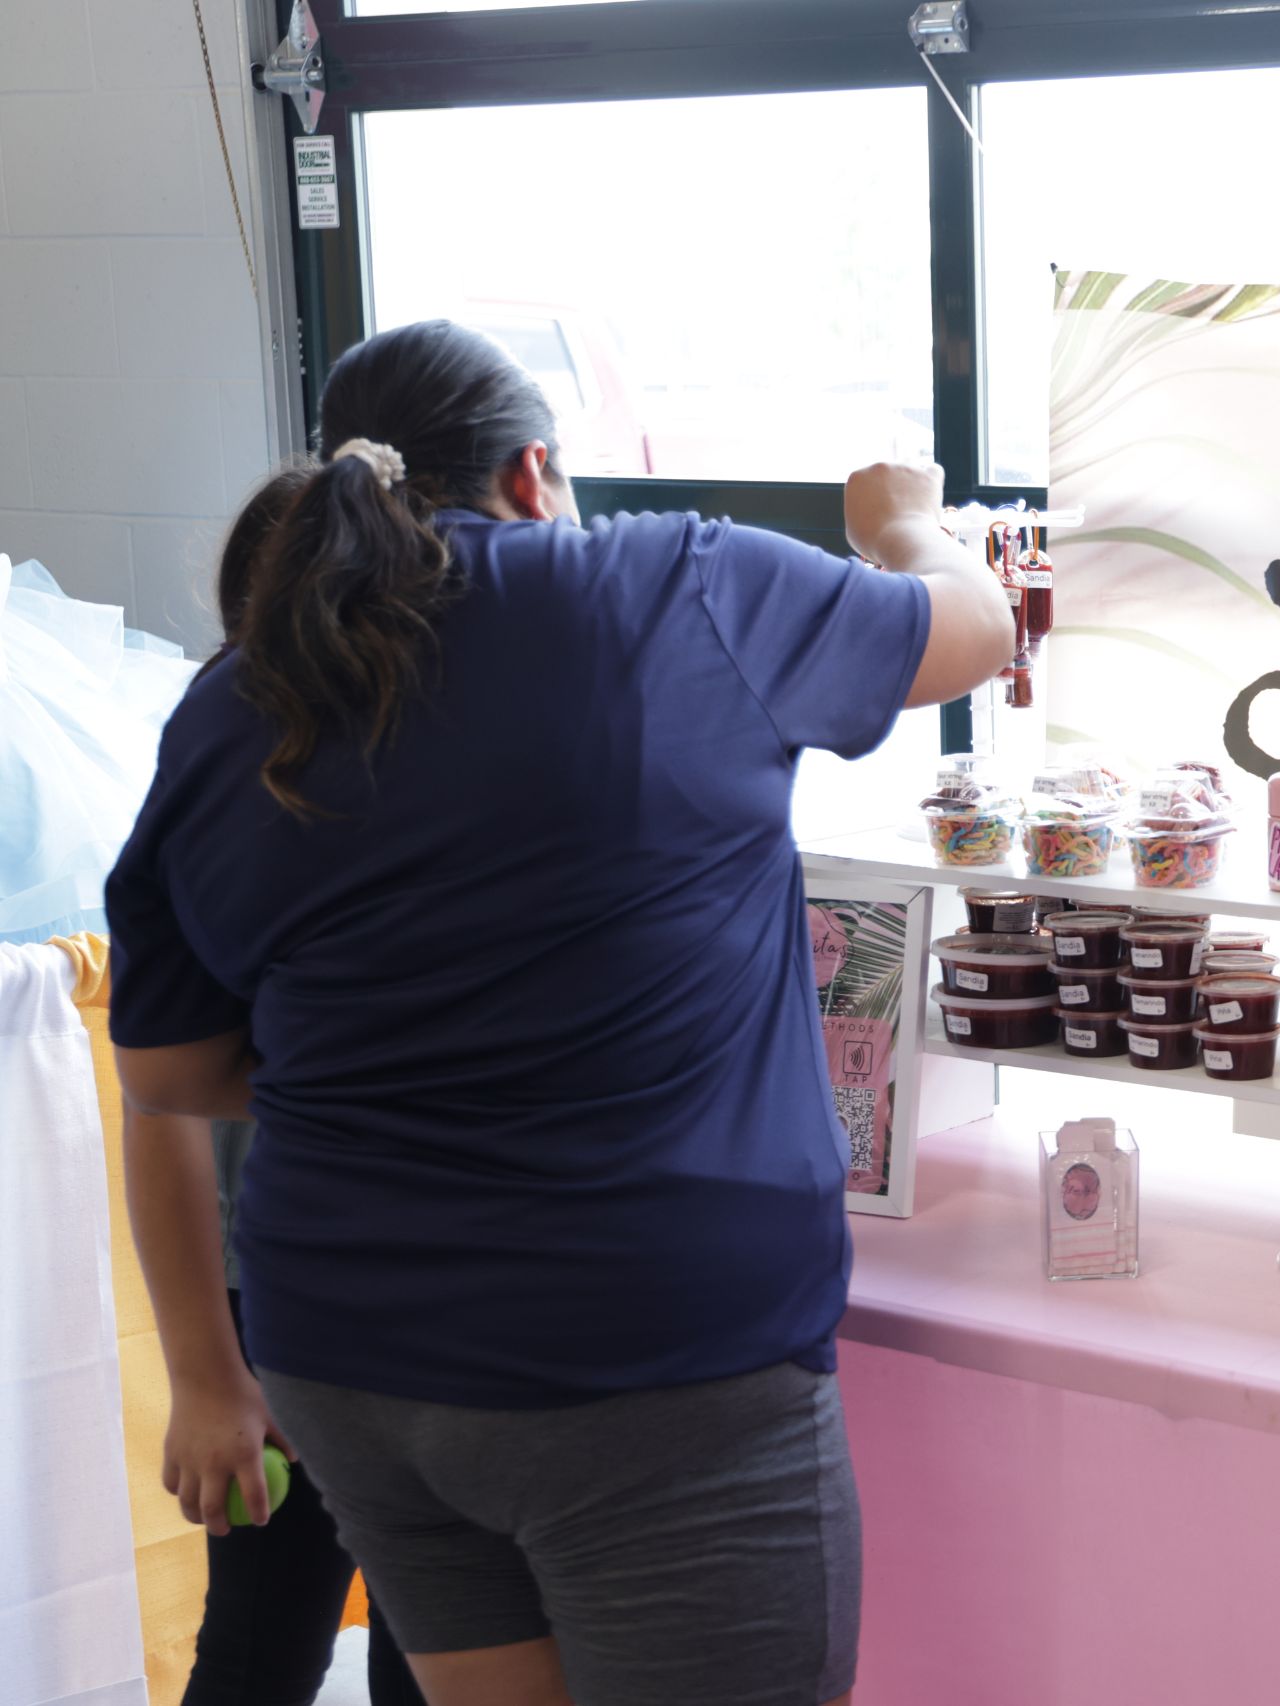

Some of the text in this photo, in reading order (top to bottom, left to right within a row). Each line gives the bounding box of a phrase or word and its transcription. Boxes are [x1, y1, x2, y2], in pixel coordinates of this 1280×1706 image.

[299, 150, 331, 160] INDUSTRIAL
[1025, 573, 1050, 582] Sandia
[813, 932, 848, 958] itas
[958, 973, 985, 985] Sandia
[822, 1022, 875, 1033] ETHODS
[1068, 1031, 1092, 1041] Sandia
[844, 1075, 868, 1084] TAP
